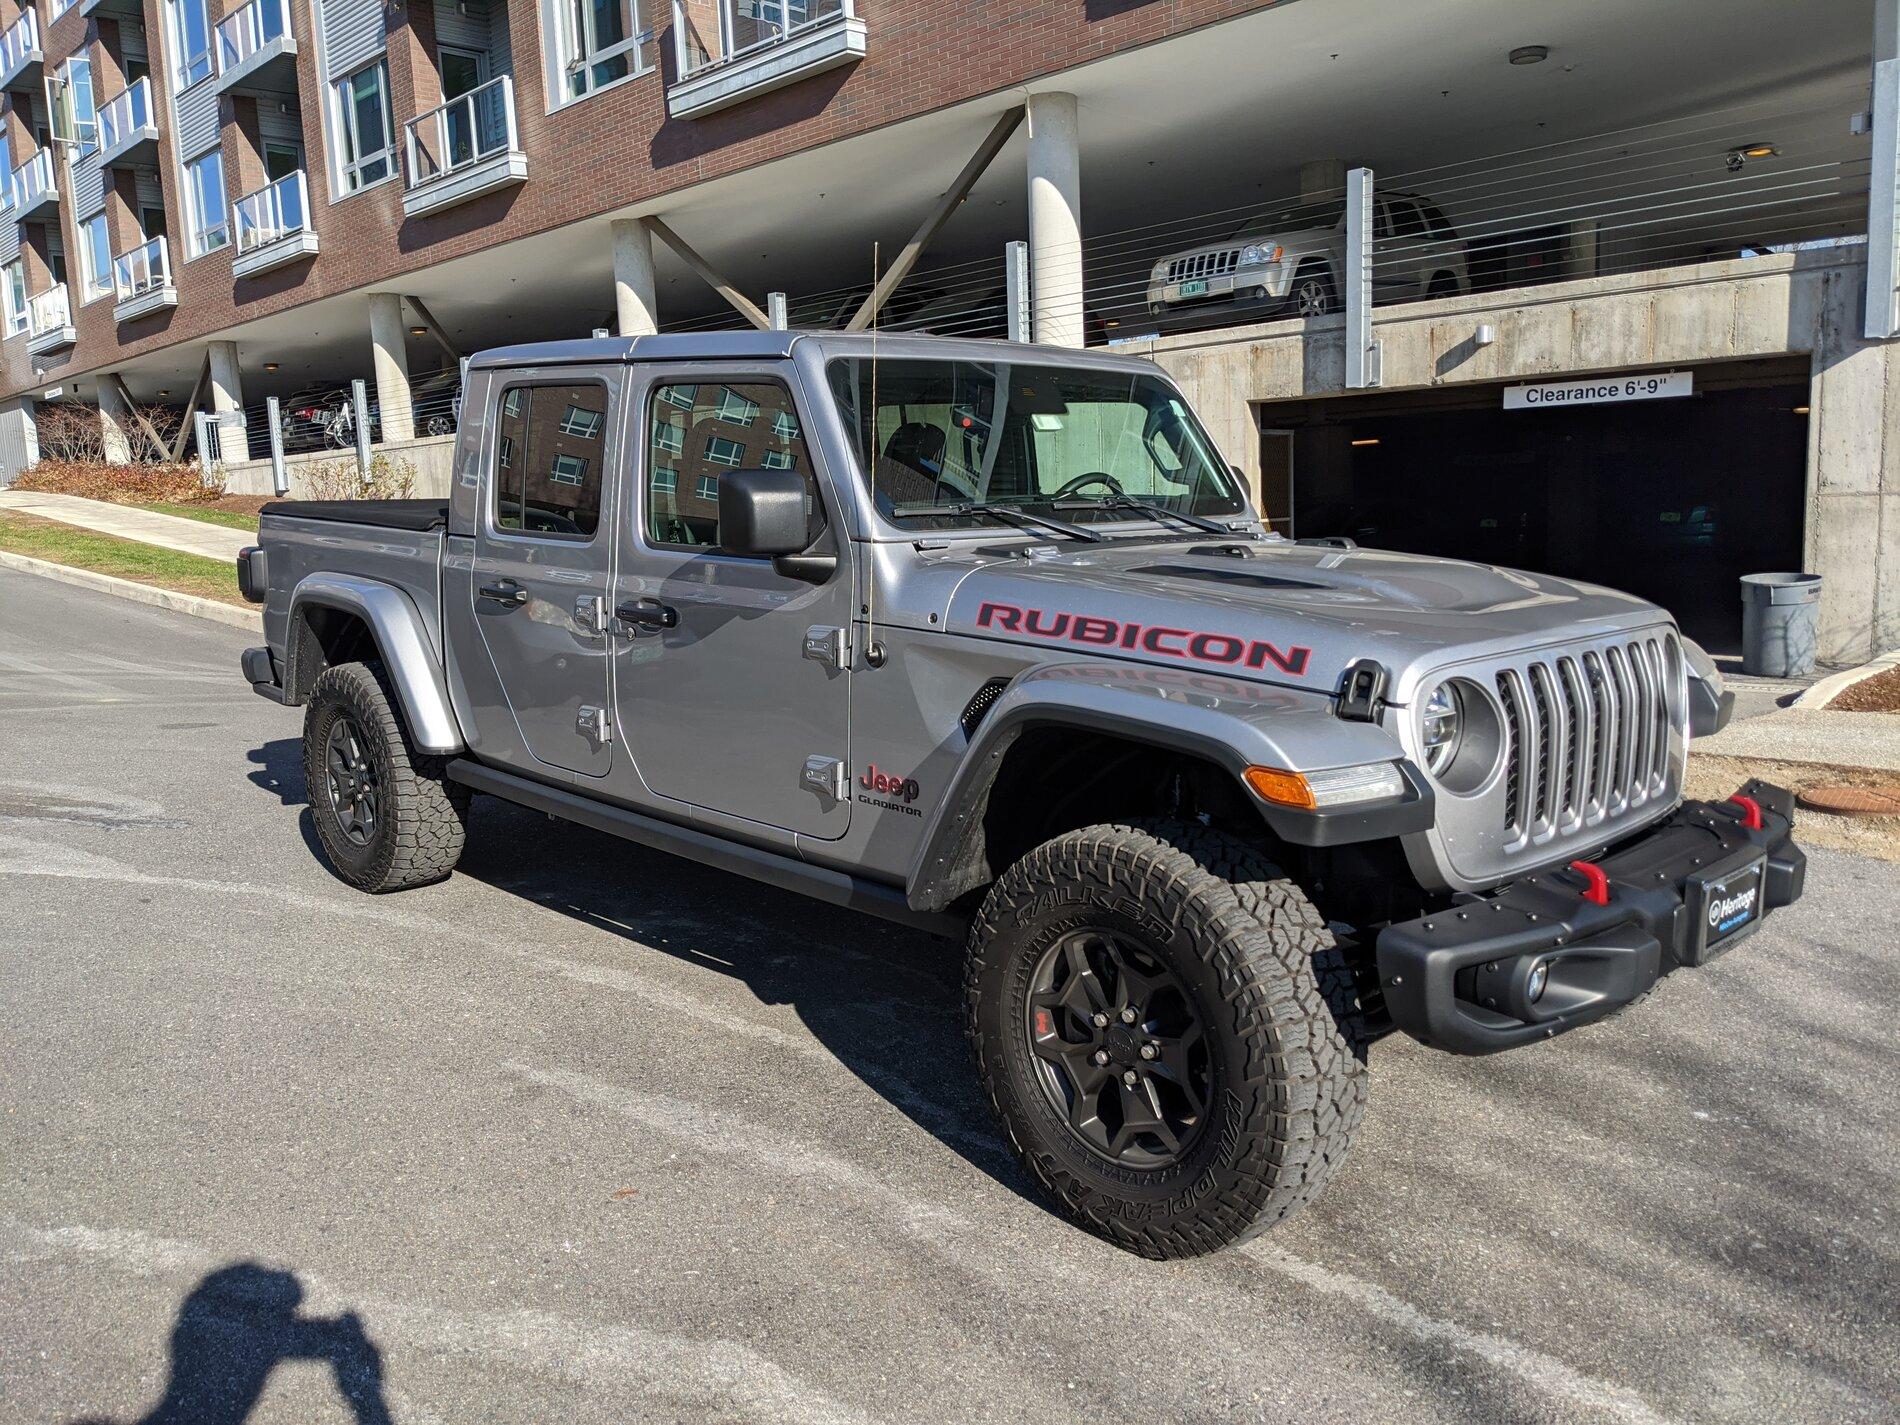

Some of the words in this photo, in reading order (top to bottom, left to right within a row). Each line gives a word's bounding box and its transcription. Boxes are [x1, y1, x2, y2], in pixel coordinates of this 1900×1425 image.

[1526, 385, 1618, 403] Clearance
[1625, 378, 1667, 396] 6'-9"
[976, 601, 1312, 676] RUBICON
[859, 764, 919, 804] Jeep
[858, 794, 922, 818] GLADIATOR
[1720, 888, 1756, 918] Heritage
